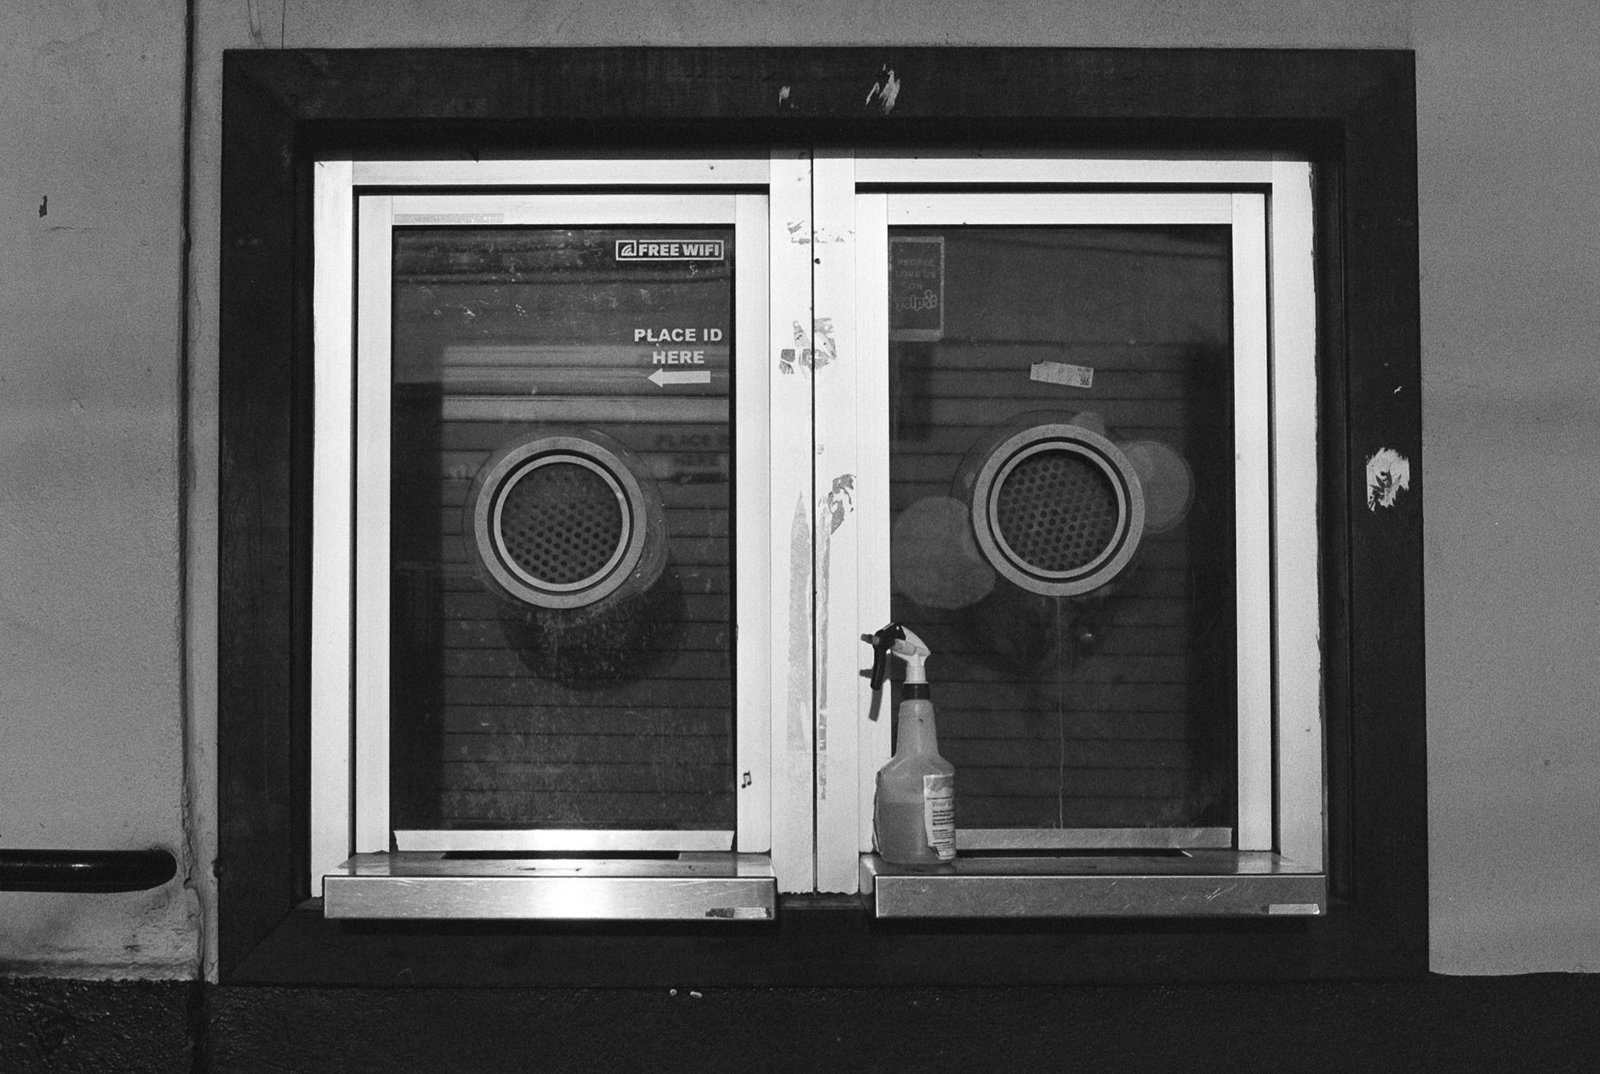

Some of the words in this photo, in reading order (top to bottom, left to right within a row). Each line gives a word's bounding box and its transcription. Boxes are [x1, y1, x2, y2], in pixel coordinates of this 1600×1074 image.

[638, 243, 680, 256] FREE
[682, 243, 720, 256] WIFI
[894, 294, 925, 312] yelp
[634, 328, 697, 342] PLACE
[703, 328, 723, 342] ID
[652, 350, 705, 364] HERE
